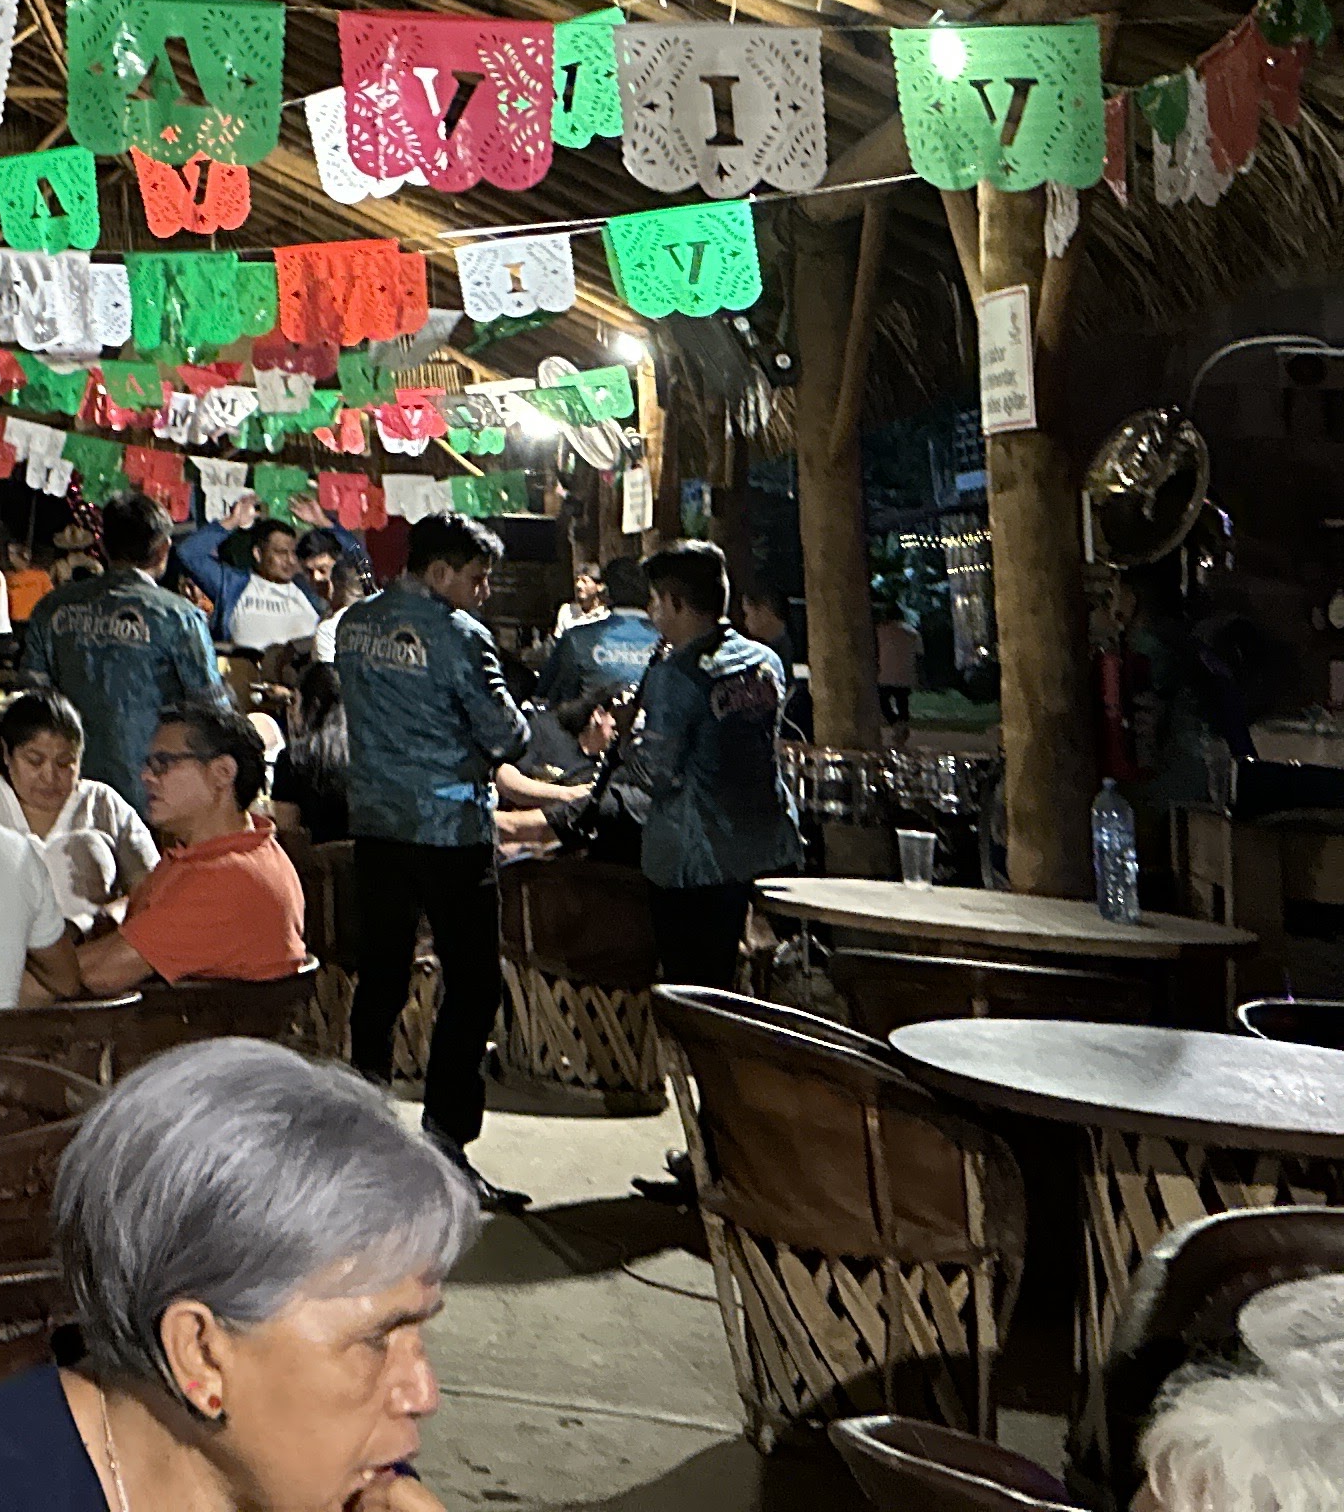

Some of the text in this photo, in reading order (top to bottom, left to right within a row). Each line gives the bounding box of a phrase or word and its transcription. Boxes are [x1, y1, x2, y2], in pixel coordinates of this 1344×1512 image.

[126, 35, 212, 109] A
[413, 65, 486, 142] V
[698, 75, 742, 148] I
[968, 77, 1039, 148] V
[31, 175, 71, 219] A
[503, 262, 529, 294] I
[662, 241, 705, 285] V
